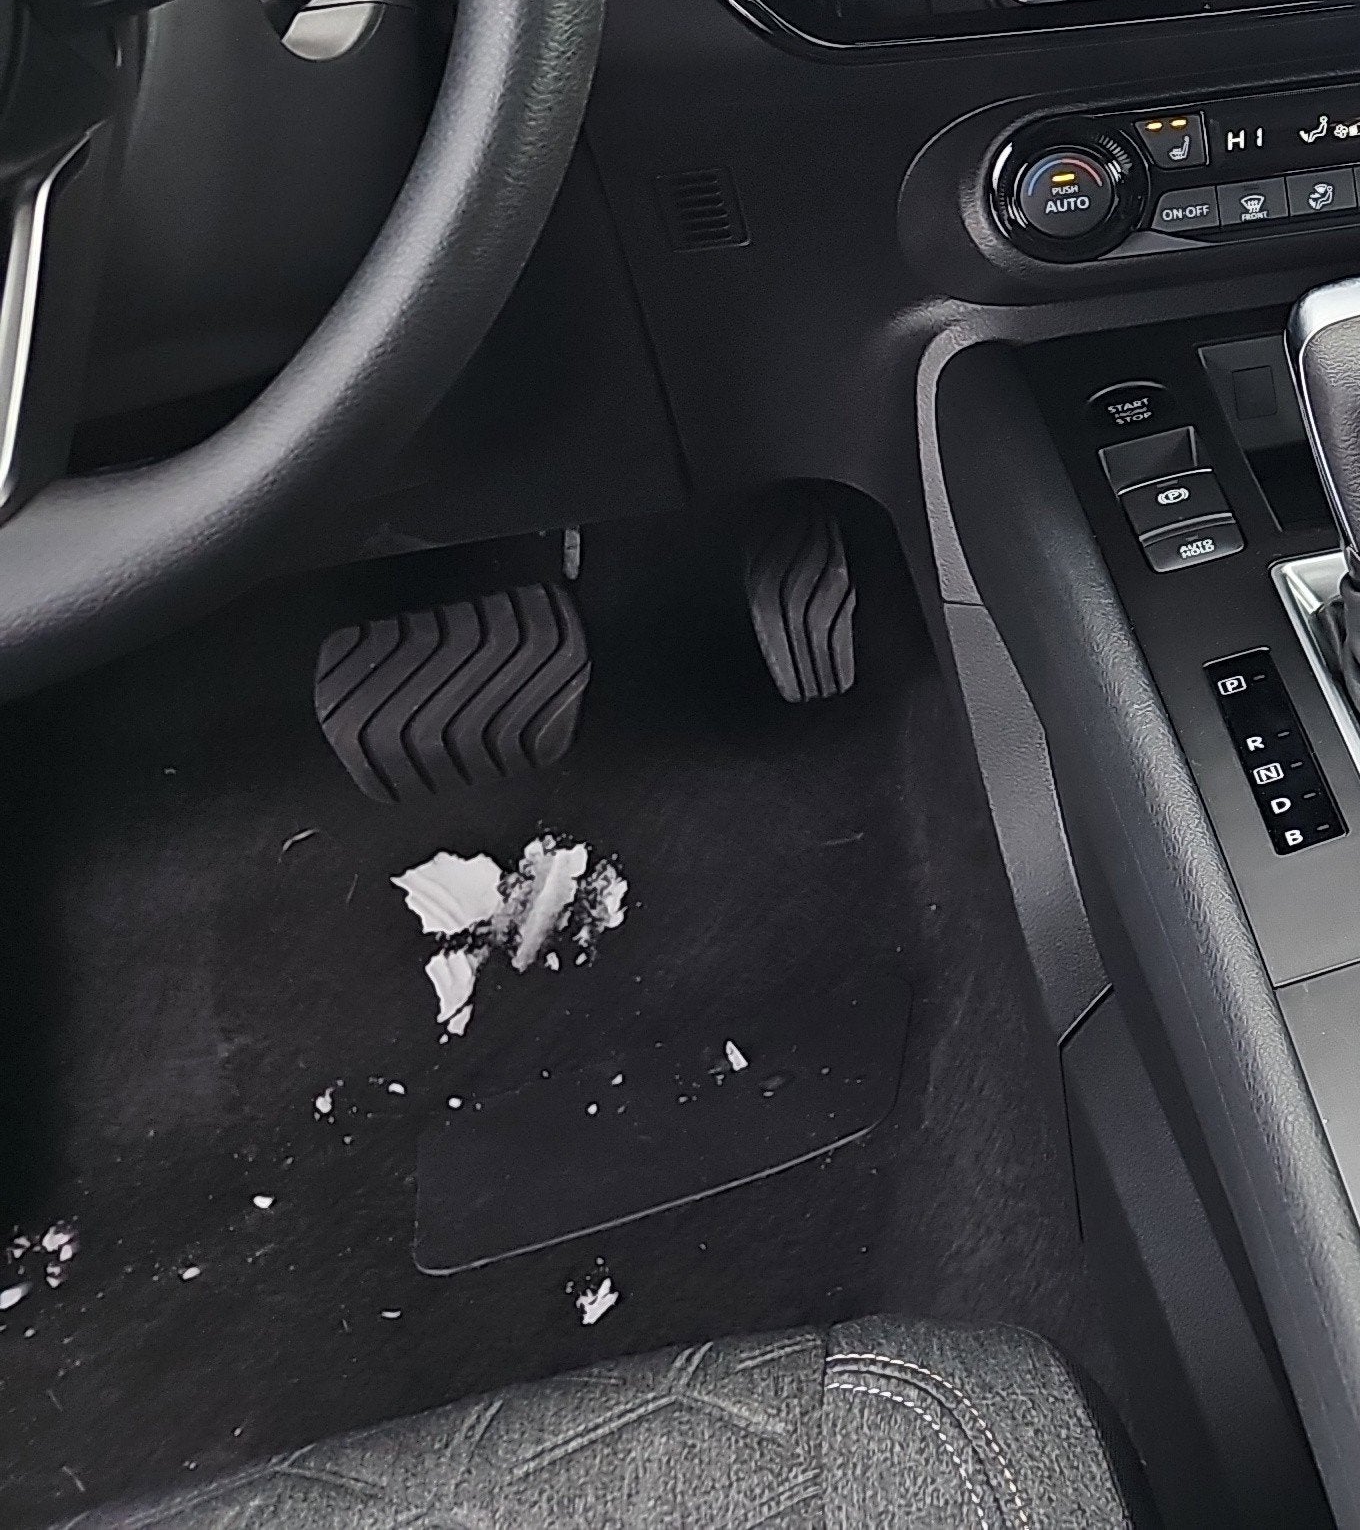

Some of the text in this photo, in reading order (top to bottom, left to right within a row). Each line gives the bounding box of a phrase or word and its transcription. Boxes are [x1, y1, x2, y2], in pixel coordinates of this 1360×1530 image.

[1051, 184, 1079, 195] PUSH
[1045, 197, 1090, 214] AUTO
[1241, 210, 1269, 222] FRONT
[1107, 397, 1149, 413] START
[1116, 411, 1152, 425] STOP
[1180, 538, 1213, 553] AUTO
[1181, 544, 1214, 558] HOLD
[1246, 736, 1265, 751] R
[1270, 797, 1291, 814] D
[1284, 829, 1303, 846] B
